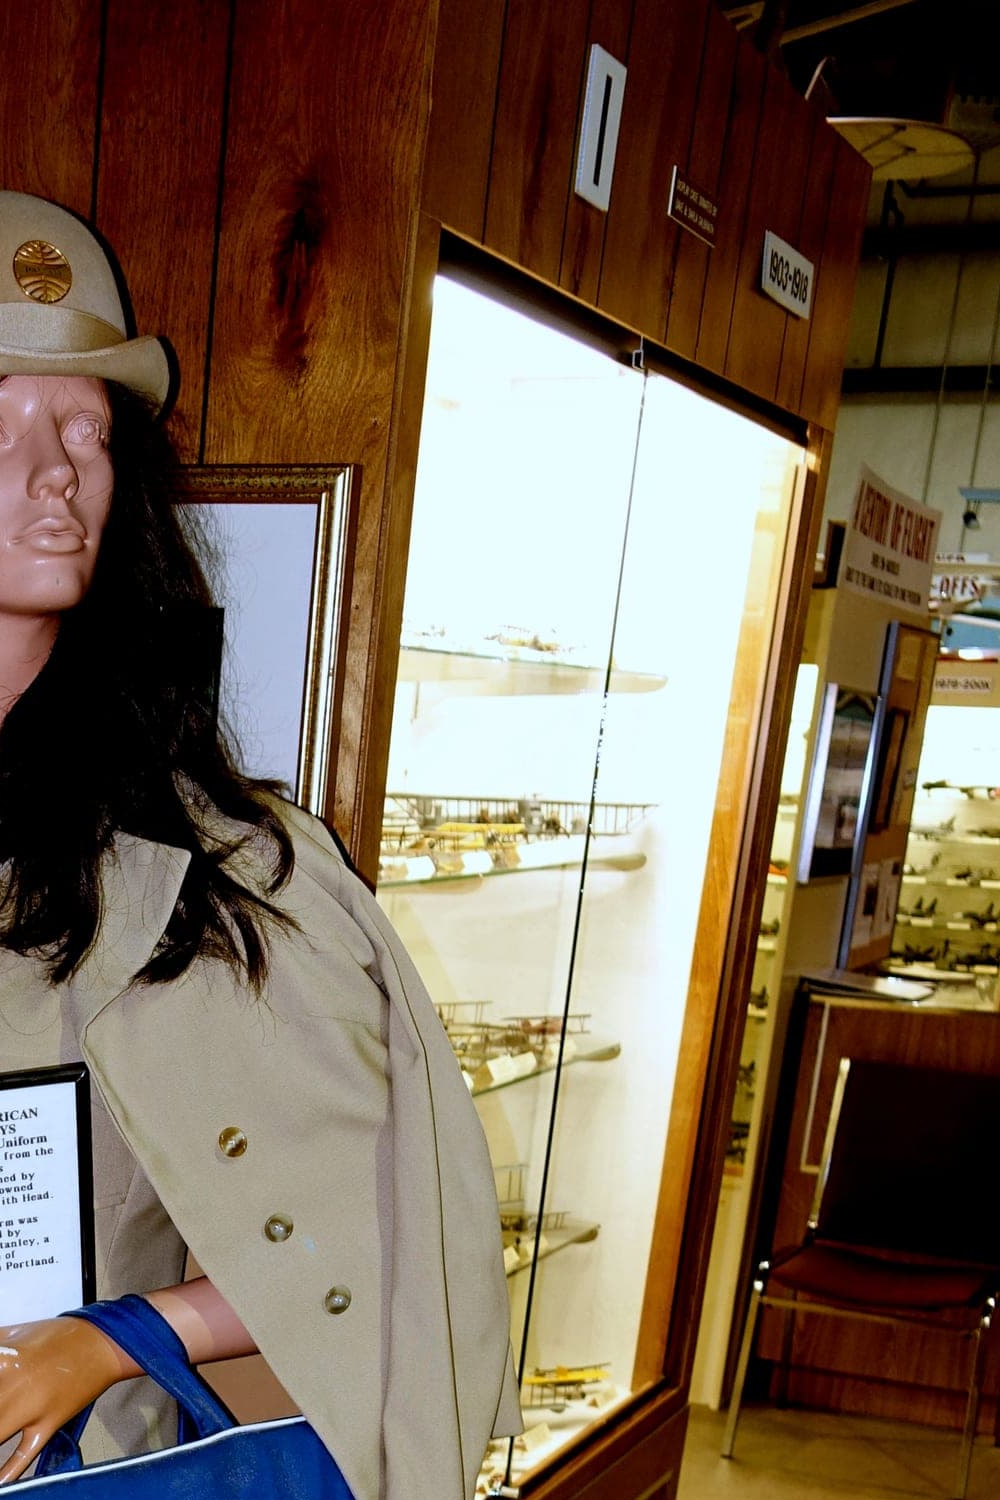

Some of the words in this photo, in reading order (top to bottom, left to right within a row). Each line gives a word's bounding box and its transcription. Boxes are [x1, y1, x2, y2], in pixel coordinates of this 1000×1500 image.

[4, 1150, 31, 1161] from
[35, 1146, 54, 1157] the
[21, 1171, 35, 1182] by
[19, 1215, 38, 1225] was
[8, 1229, 21, 1239] by
[5, 1250, 15, 1260] of
[6, 1257, 59, 1271] Portland.
